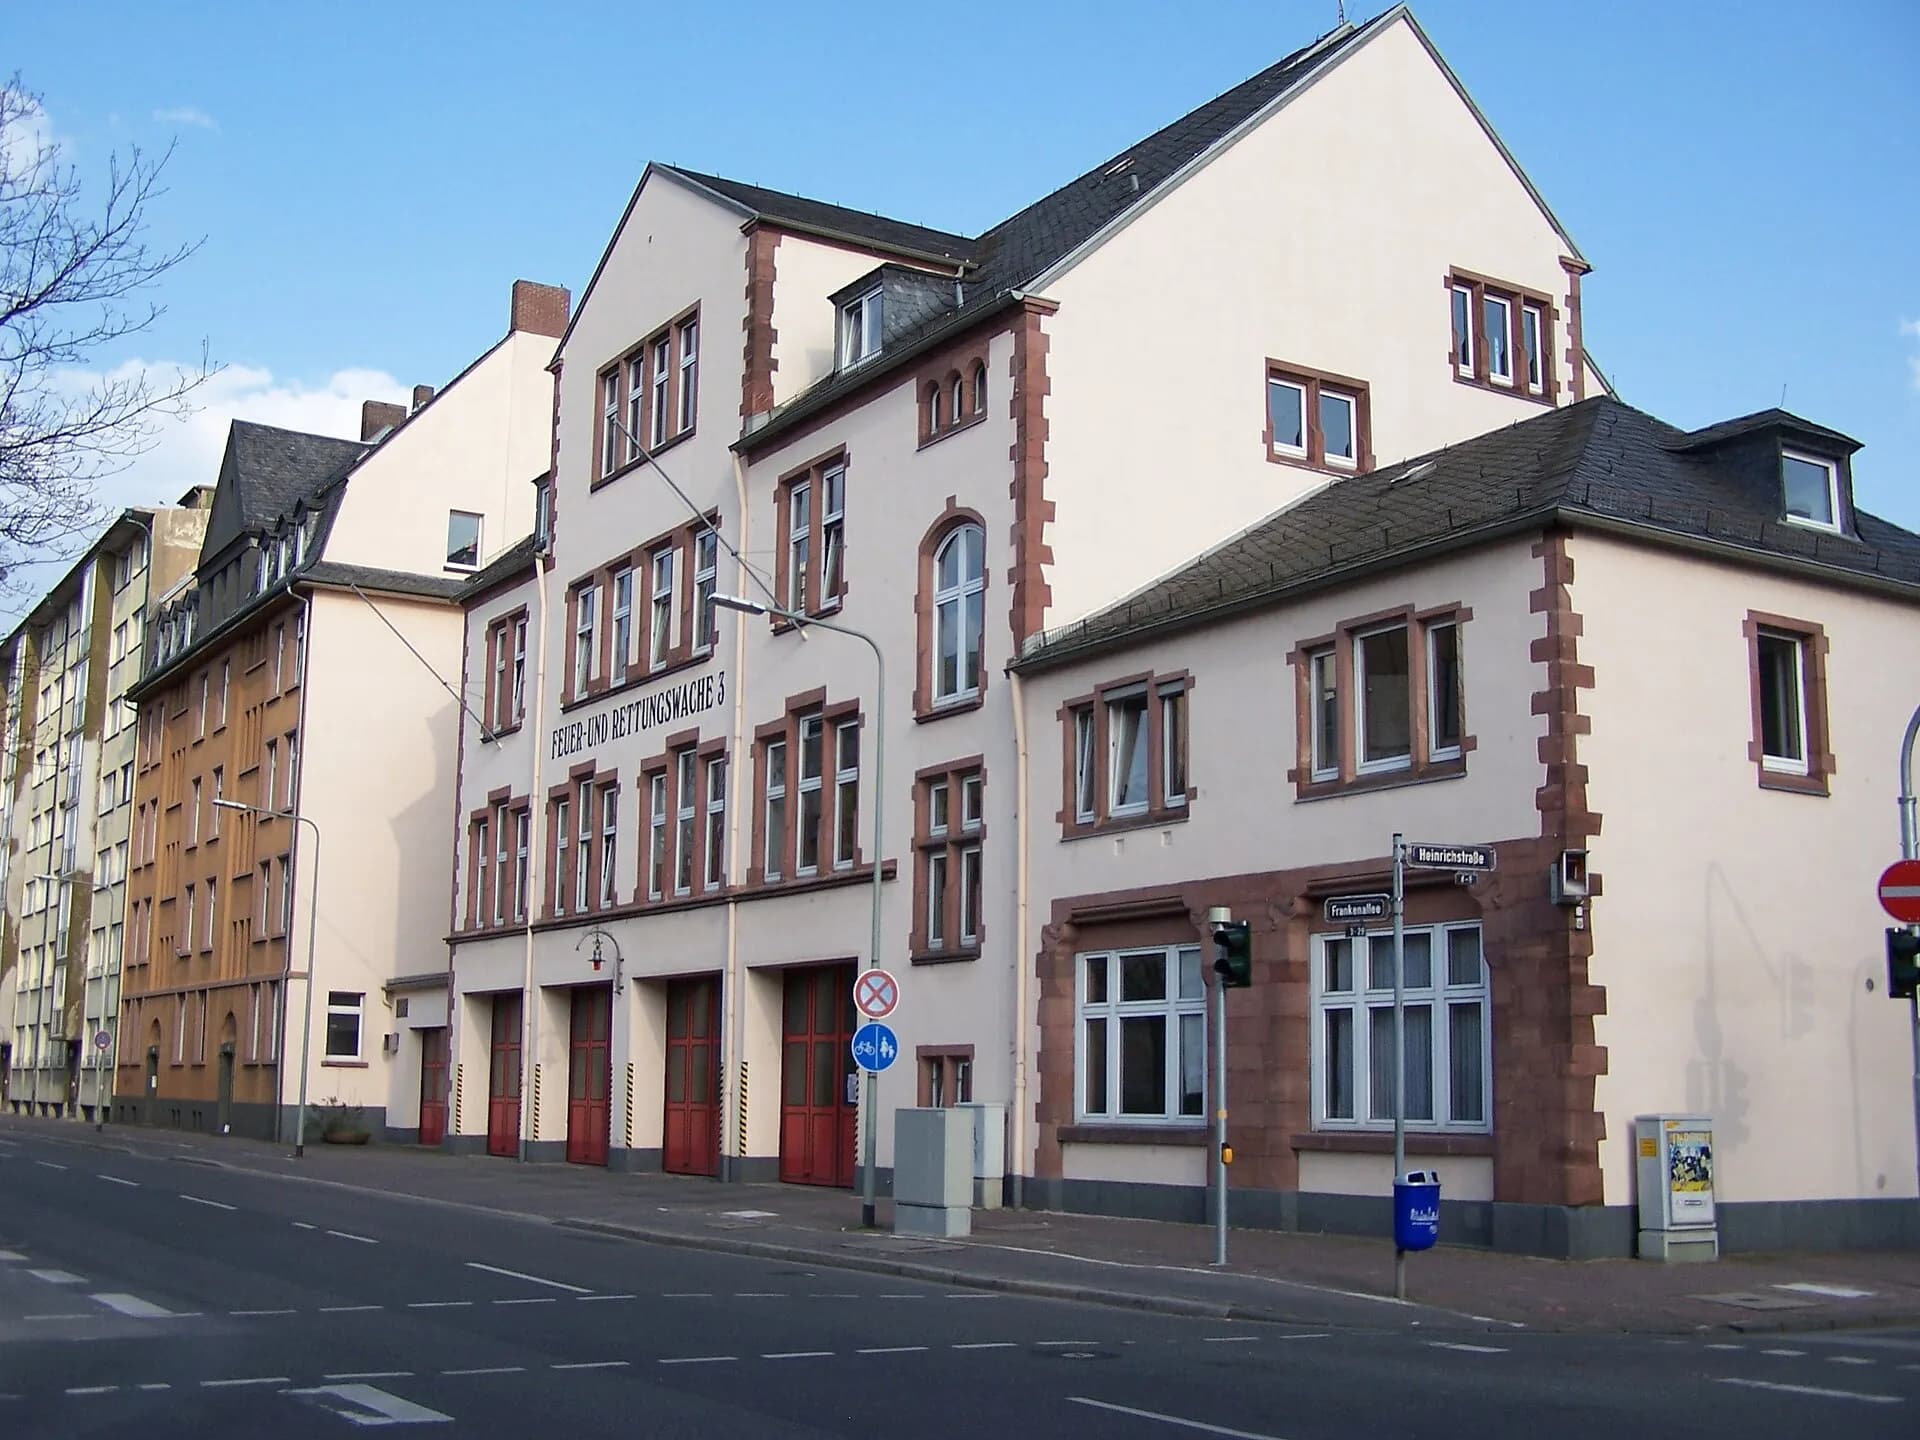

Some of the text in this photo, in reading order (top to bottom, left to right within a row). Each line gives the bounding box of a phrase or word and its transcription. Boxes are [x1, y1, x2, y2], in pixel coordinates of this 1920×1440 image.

[611, 675, 714, 741] RETTUNGSWACHE
[717, 671, 725, 706] 3
[1419, 847, 1485, 865] Heinrichstraße
[1331, 903, 1381, 917] Frankenallee
